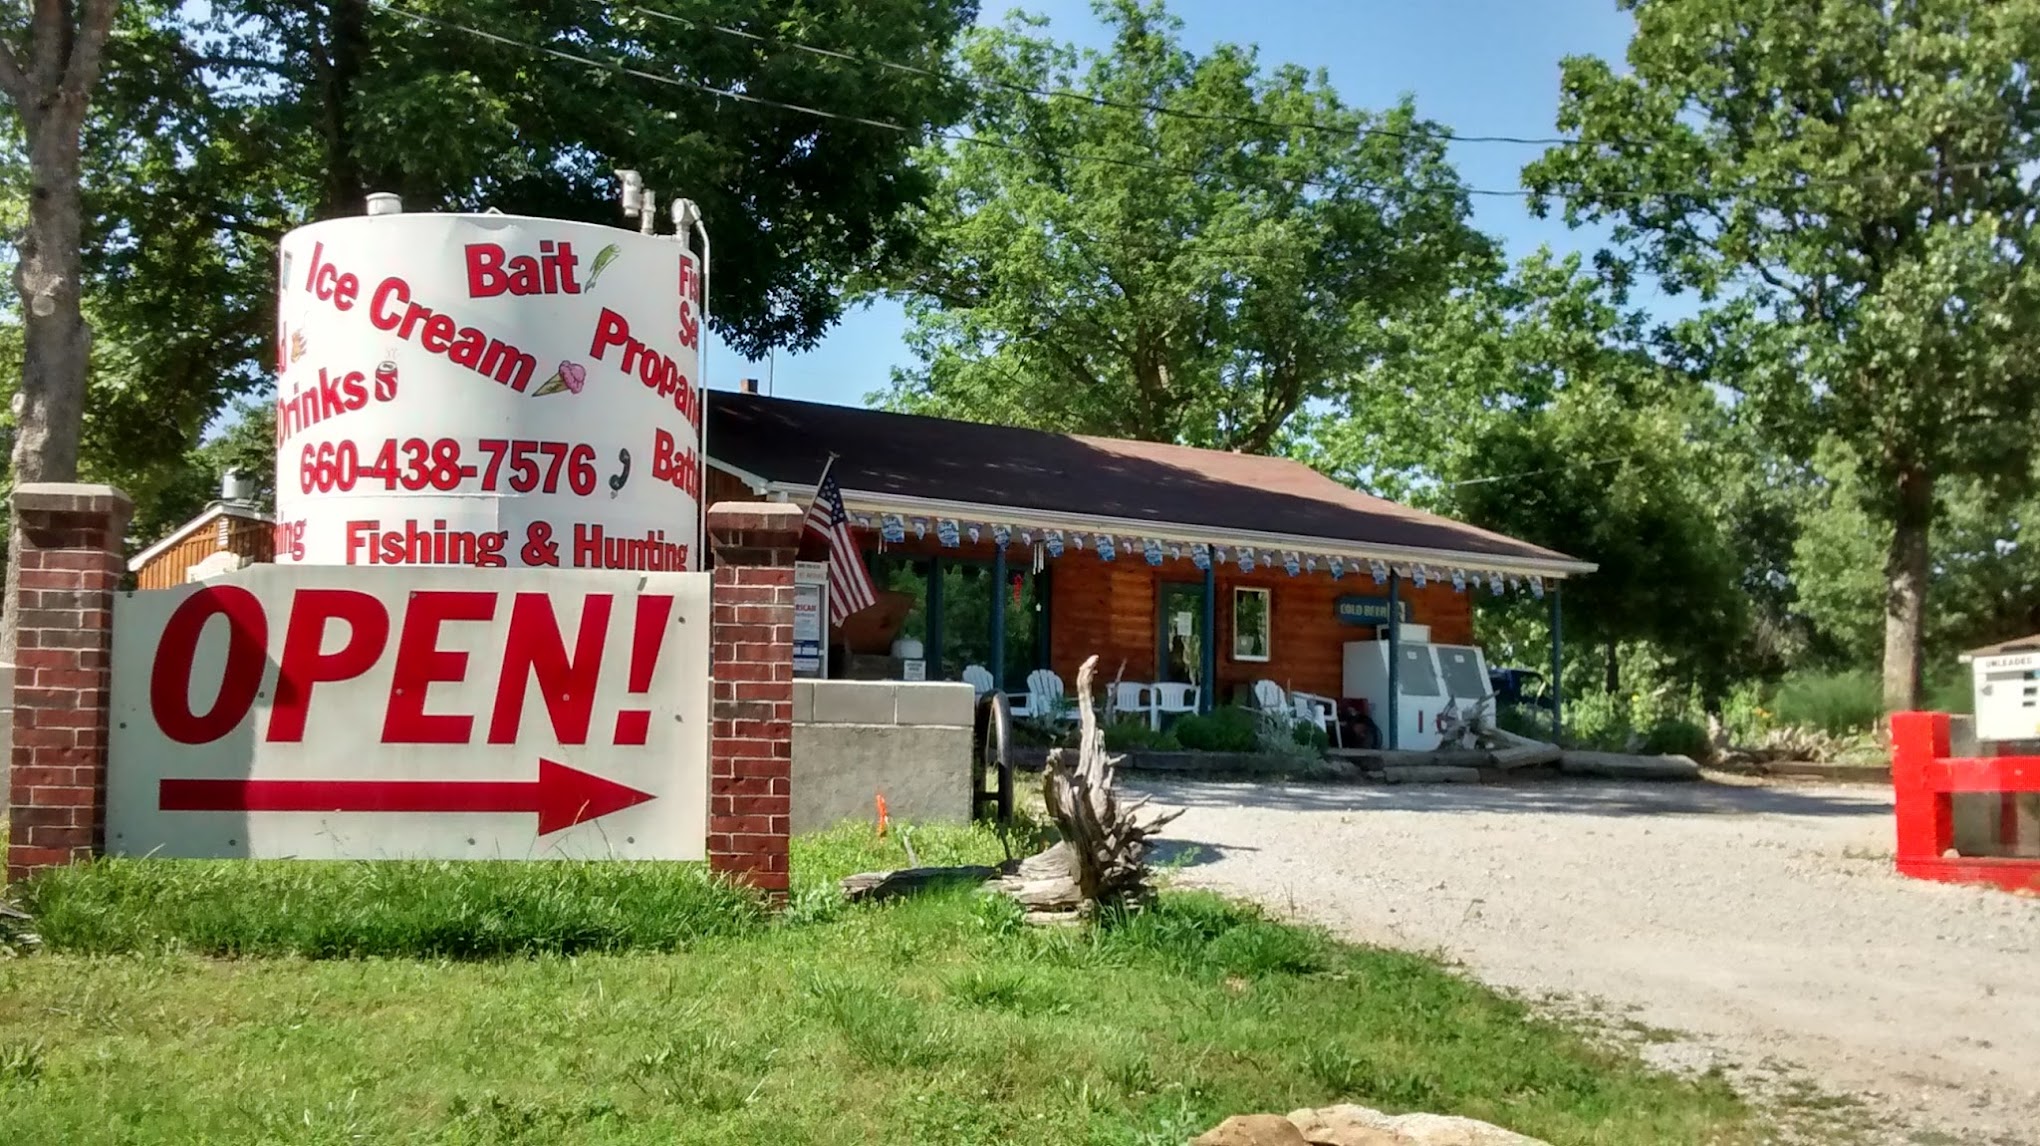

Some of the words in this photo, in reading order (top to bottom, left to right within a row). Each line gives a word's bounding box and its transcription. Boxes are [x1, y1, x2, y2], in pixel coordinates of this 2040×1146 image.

[465, 240, 580, 298] Bait
[305, 241, 359, 312] Ice
[369, 276, 537, 393] Cream
[590, 307, 699, 436] Propan
[300, 438, 597, 496] 660-438-7576
[346, 519, 508, 568] Fishing
[520, 521, 559, 567] &
[574, 524, 688, 572] Hunting
[1340, 603, 1363, 616] COLD
[149, 585, 674, 745] OPEN!
